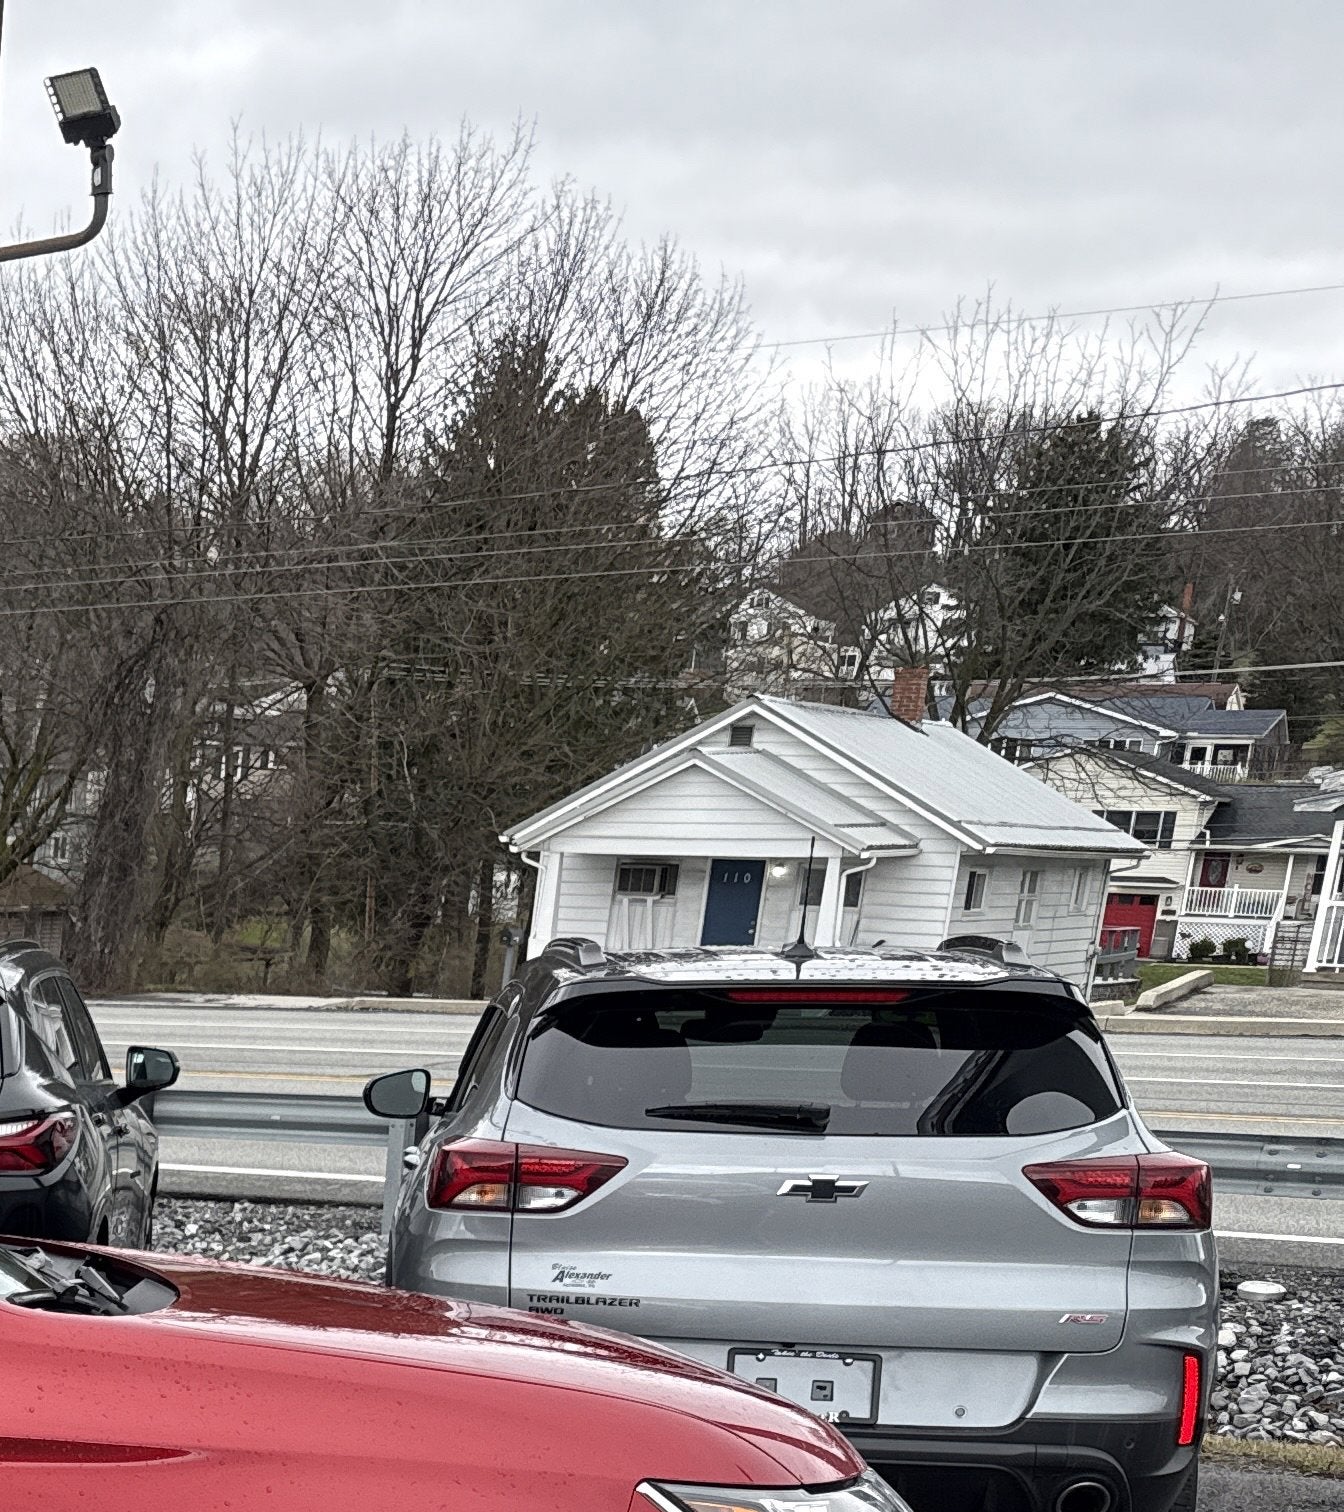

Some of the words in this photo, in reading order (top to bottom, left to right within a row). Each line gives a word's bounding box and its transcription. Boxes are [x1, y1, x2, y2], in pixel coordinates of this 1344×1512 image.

[723, 872, 752, 884] 110
[552, 1269, 613, 1283] Alexander
[527, 1293, 641, 1308] TRAILBLAZER
[528, 1306, 565, 1315] AWD
[1058, 1313, 1109, 1324] RS
